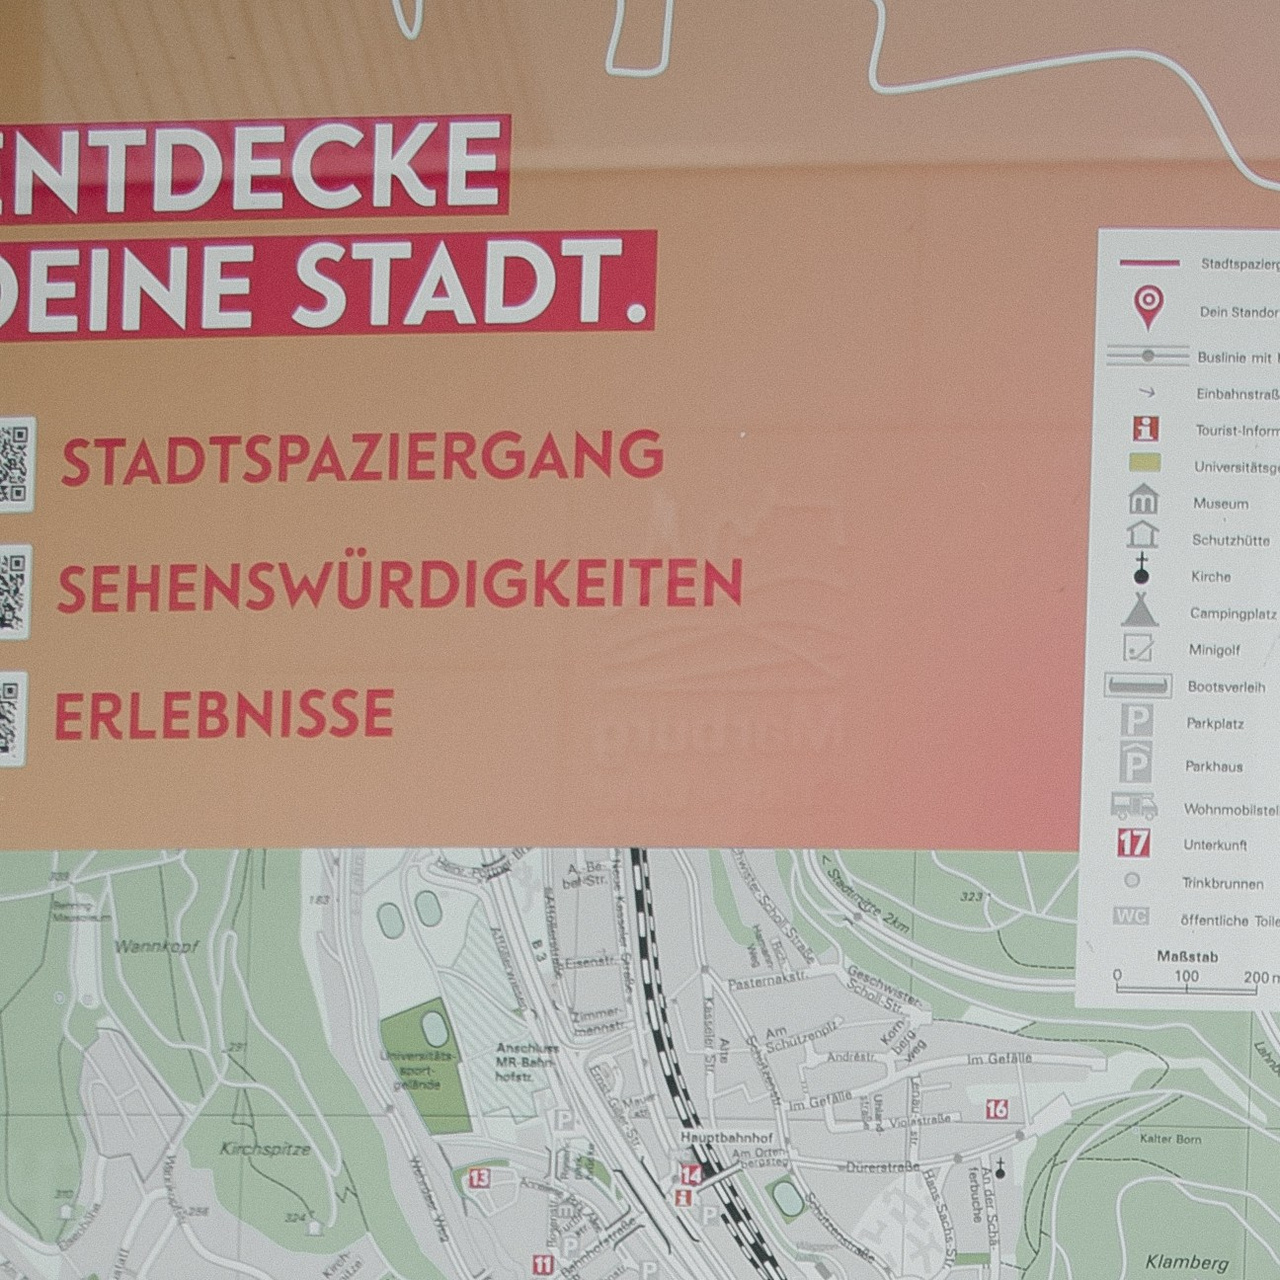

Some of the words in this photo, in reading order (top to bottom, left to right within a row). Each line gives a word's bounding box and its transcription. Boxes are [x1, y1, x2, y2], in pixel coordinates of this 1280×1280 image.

[0, 121, 501, 216] NTDECKE
[0, 246, 254, 332] EINE
[292, 239, 647, 328] STADT.
[1200, 307, 1228, 318] Dein
[1198, 352, 1247, 364] Buslinie
[1251, 352, 1273, 364] mit
[61, 429, 664, 487] STADTSPAZIERGANG
[1193, 498, 1249, 510] Museum
[1192, 534, 1270, 547] Schutzhütte
[57, 547, 743, 614] SEHENSWÜRDIGKEITEN
[1191, 571, 1231, 583] Kirche
[1190, 607, 1277, 622] Campingplatz
[1189, 644, 1241, 659] Minigolf
[1188, 681, 1266, 694] Bootsverleih
[55, 689, 395, 741] ERLEBNISSE
[1128, 706, 1149, 734] P
[1187, 717, 1244, 732] Parkplatz
[1126, 753, 1147, 780] P
[1185, 761, 1243, 773] Parkhaus
[1120, 831, 1149, 855] 17
[1183, 839, 1248, 852] Unterkunft
[1182, 877, 1264, 891] Trinkbrunnen
[1118, 909, 1148, 924] WC
[1180, 914, 1249, 927] öffentliche
[1157, 949, 1219, 964] Maßstab
[727, 968, 810, 993] Pasternakstr.
[1113, 969, 1122, 982] 0
[1175, 969, 1199, 982] 100
[1244, 971, 1269, 984] 200
[967, 1053, 984, 1065] Im
[988, 1052, 1033, 1064] Gefälle
[987, 1100, 1008, 1118] 16
[681, 1131, 774, 1145] Hauptbahnhof
[1140, 1133, 1173, 1145] Kalter
[1177, 1133, 1202, 1145] Born
[219, 1141, 310, 1158] Kirchspitze
[846, 1160, 920, 1174] Dürerstraße
[470, 1170, 490, 1187] 13
[535, 1257, 553, 1274] 11
[1146, 1254, 1229, 1274] Klamberg
